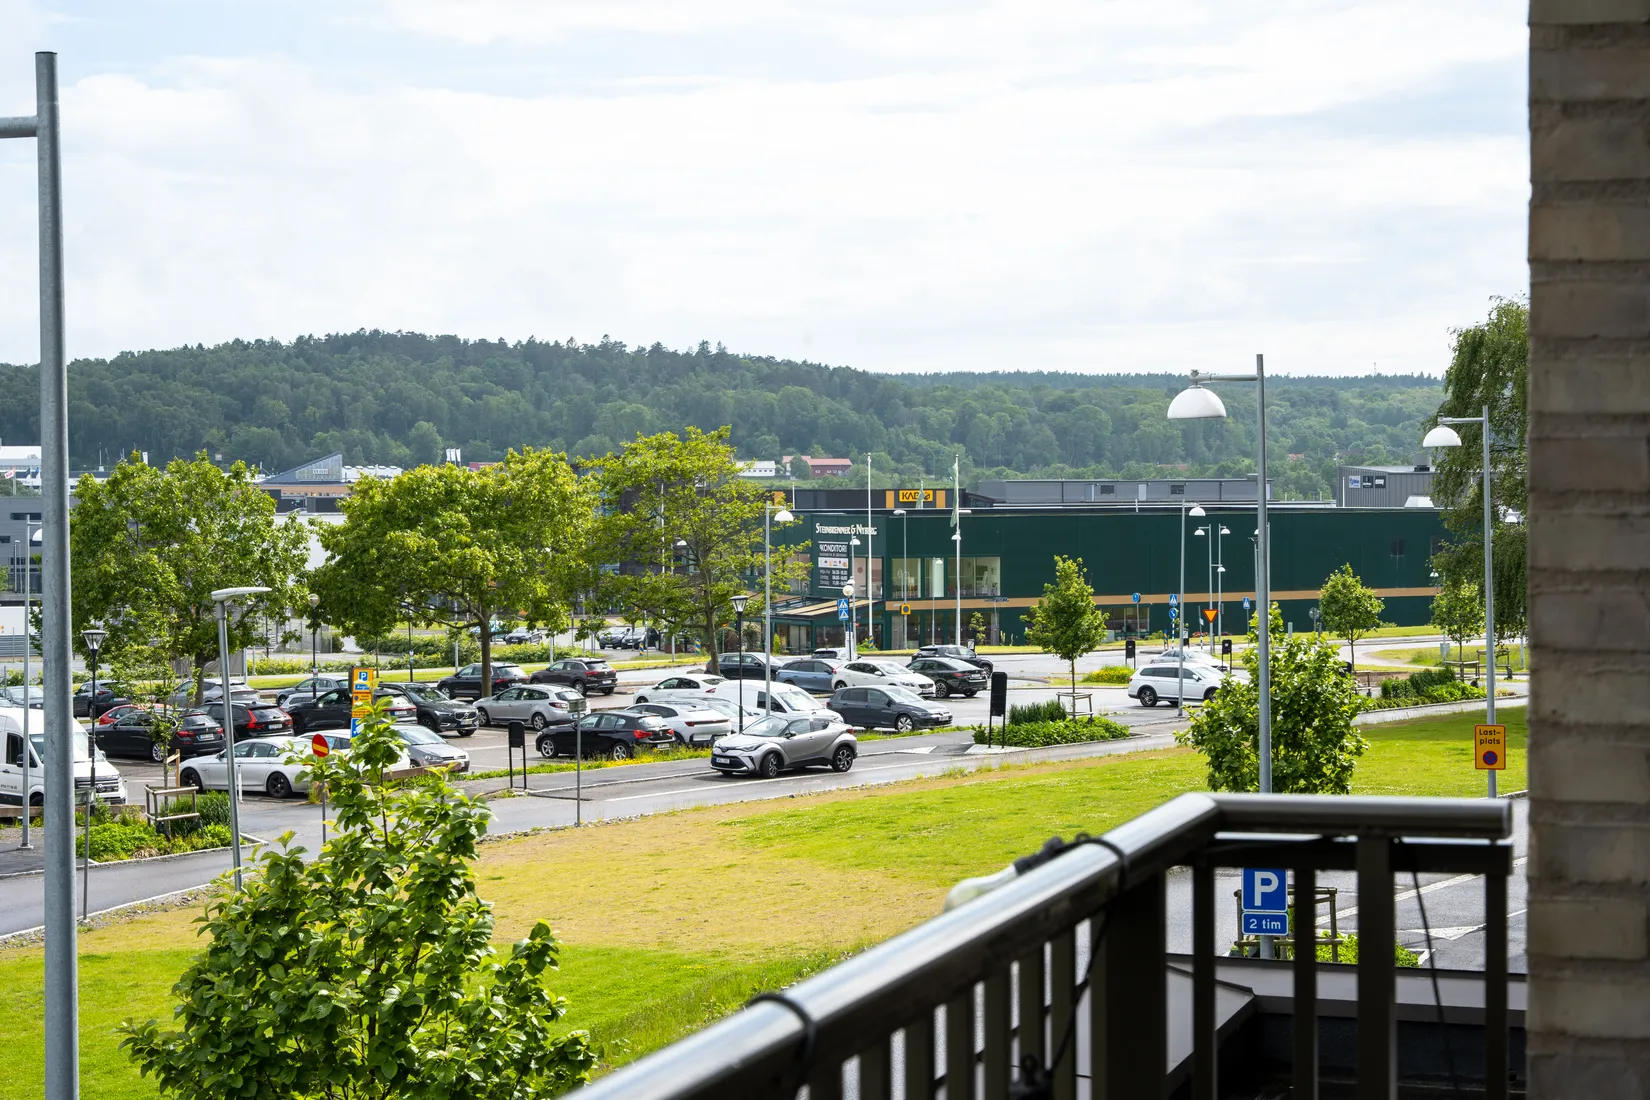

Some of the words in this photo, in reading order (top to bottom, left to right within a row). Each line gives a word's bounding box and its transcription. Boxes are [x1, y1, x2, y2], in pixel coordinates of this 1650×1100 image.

[1254, 871, 1279, 907] P
[1249, 918, 1258, 929] 2
[1262, 918, 1281, 930] tim
